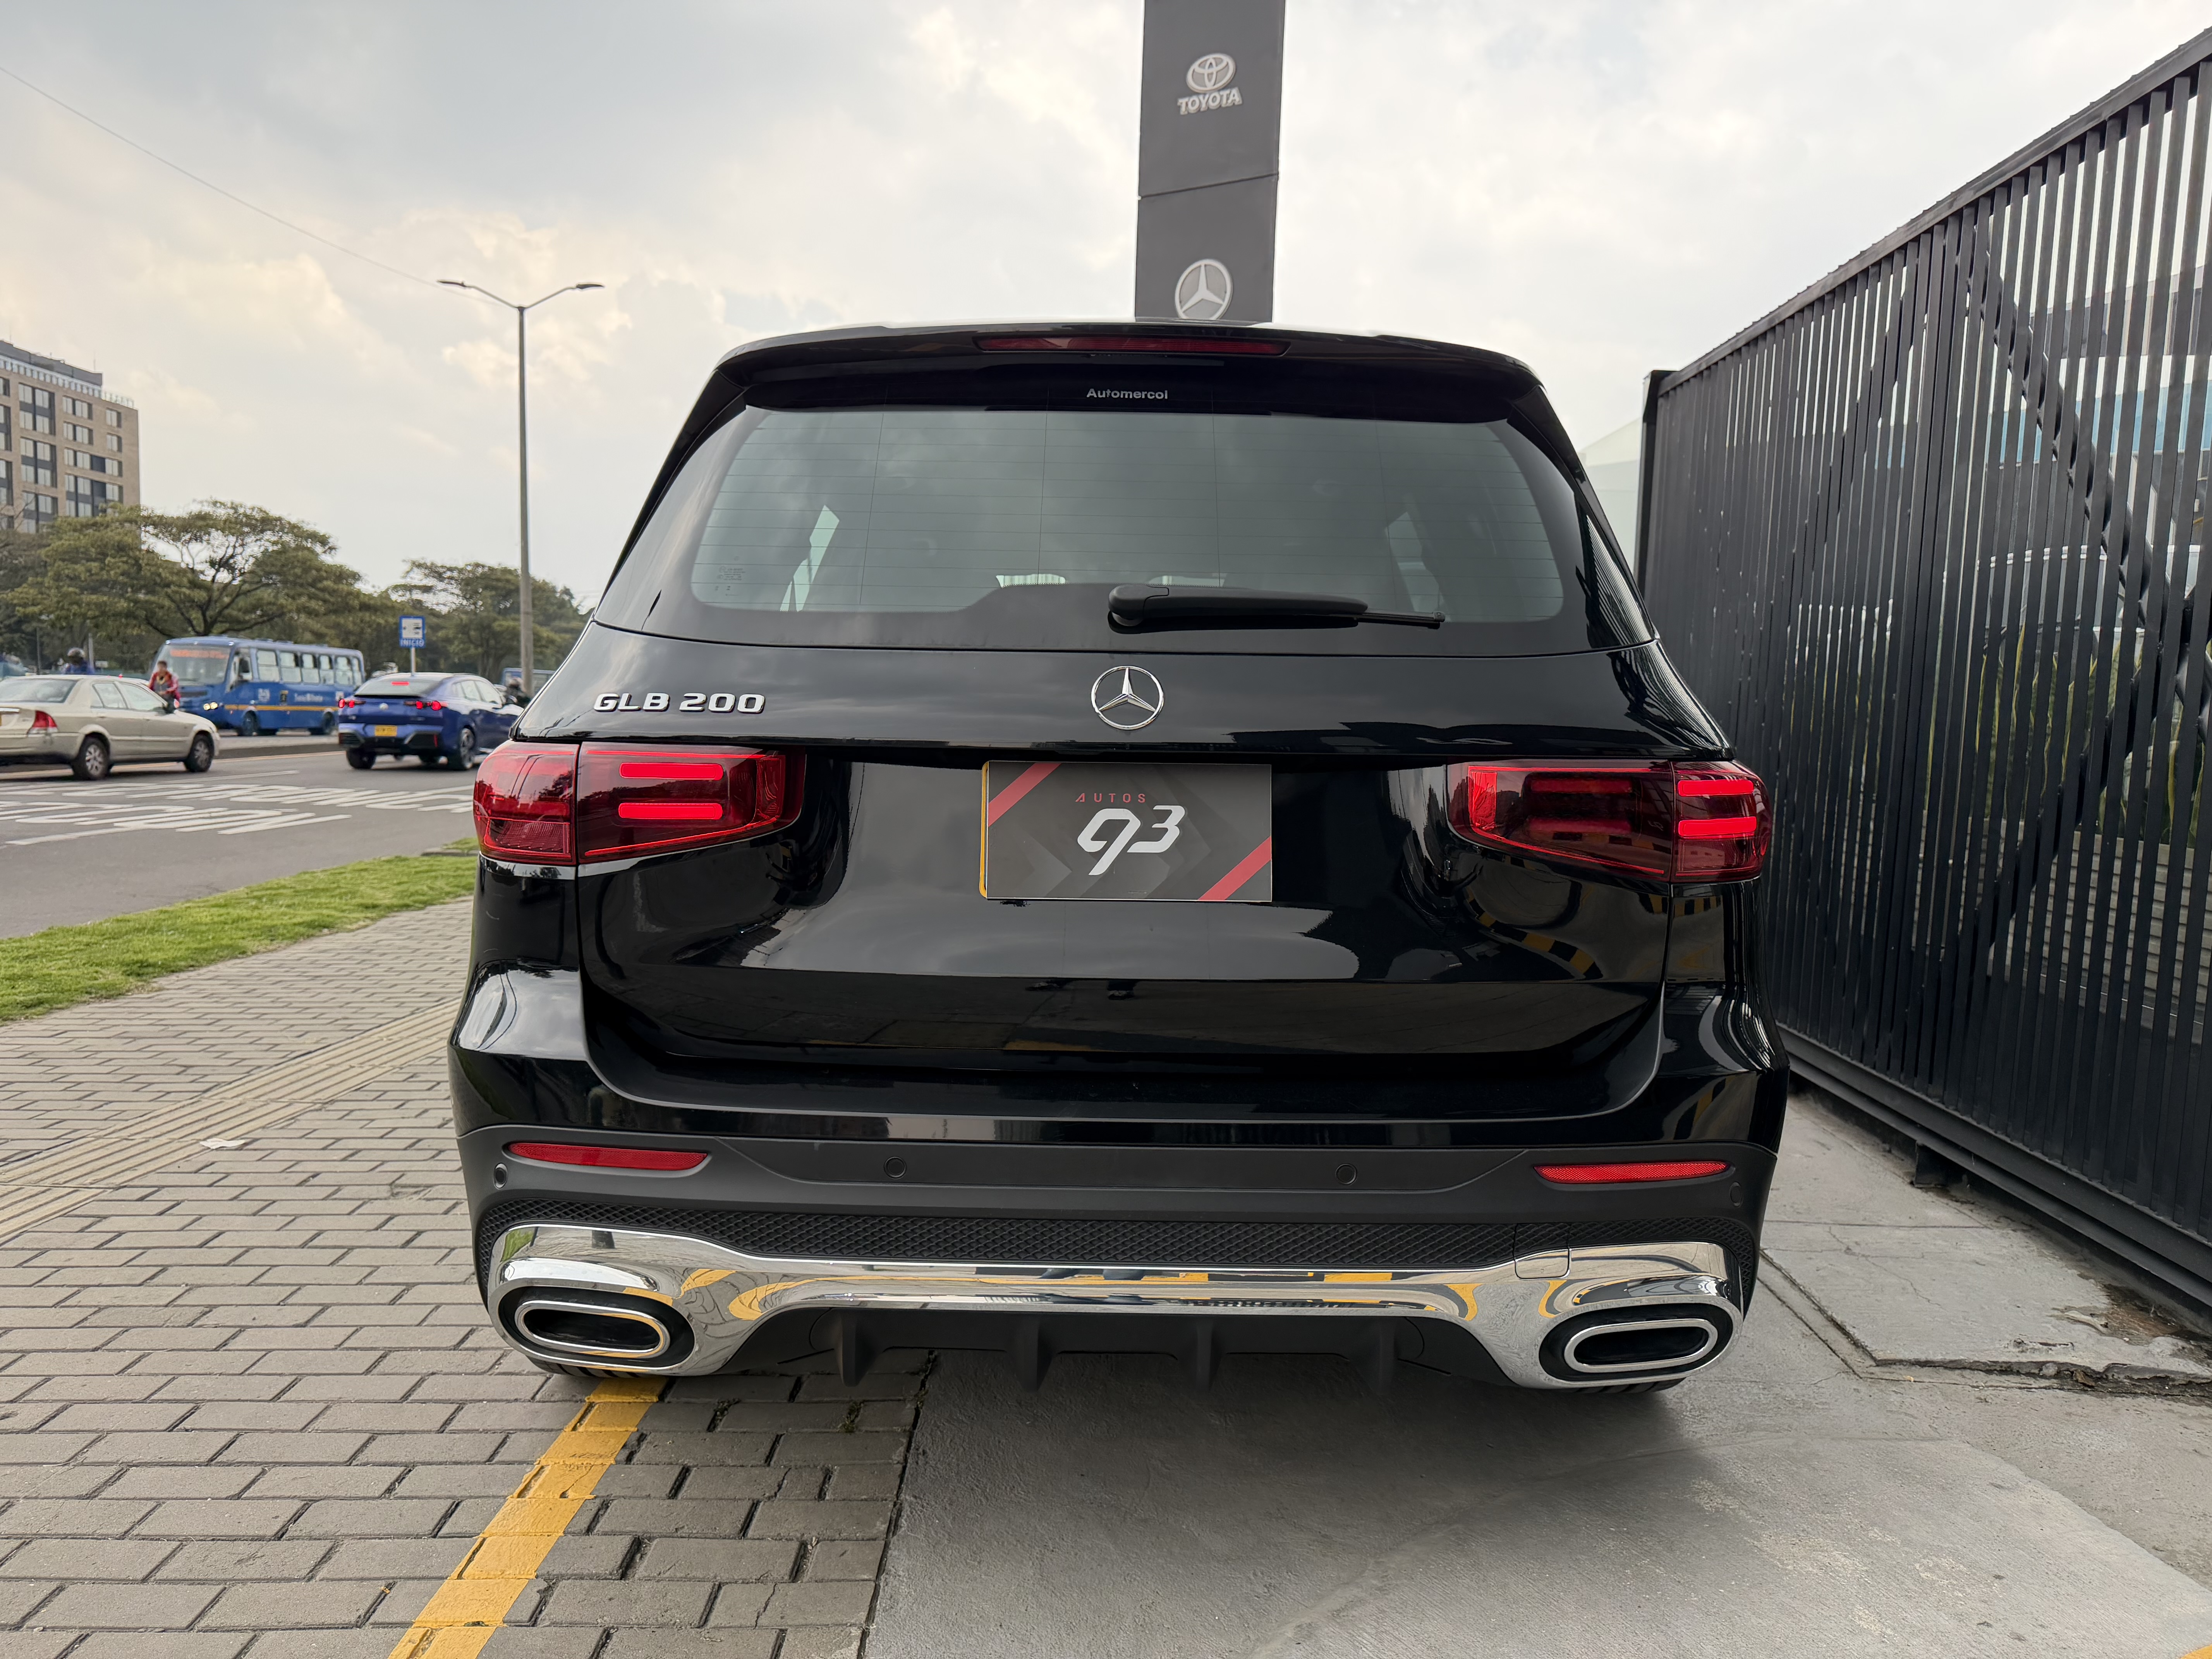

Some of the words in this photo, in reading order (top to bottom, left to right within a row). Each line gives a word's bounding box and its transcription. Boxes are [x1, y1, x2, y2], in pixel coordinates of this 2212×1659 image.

[1178, 87, 1243, 115] TOYOTA
[1086, 388, 1168, 400] Automercol
[593, 692, 671, 713] GLB
[679, 692, 766, 714] 200
[1075, 793, 1146, 803] AUTOS
[1077, 805, 1186, 876] 93
